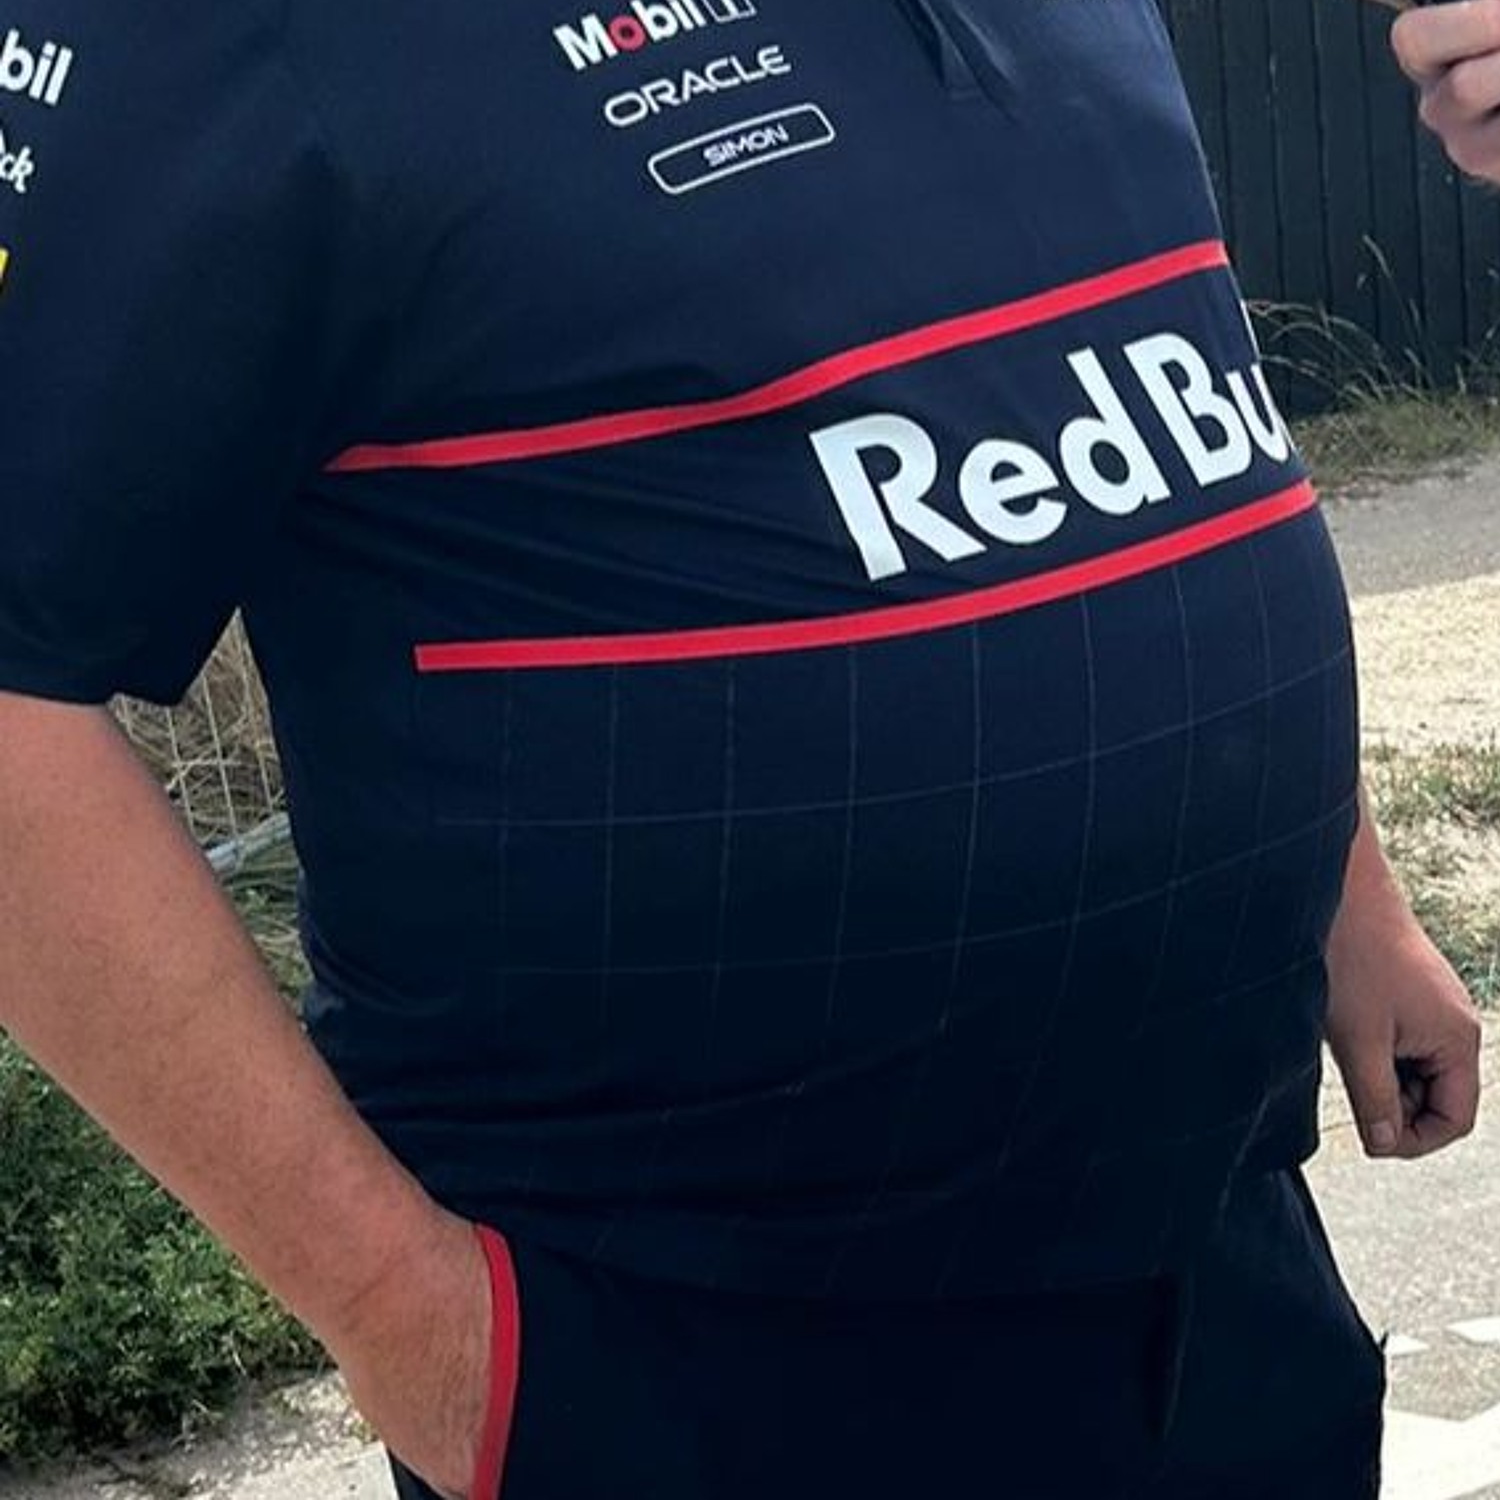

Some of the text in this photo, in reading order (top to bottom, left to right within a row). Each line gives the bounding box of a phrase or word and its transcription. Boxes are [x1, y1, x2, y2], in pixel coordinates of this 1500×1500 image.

[604, 45, 790, 127] ORACLE
[703, 123, 789, 167] SIMON
[809, 345, 1171, 582] Red
